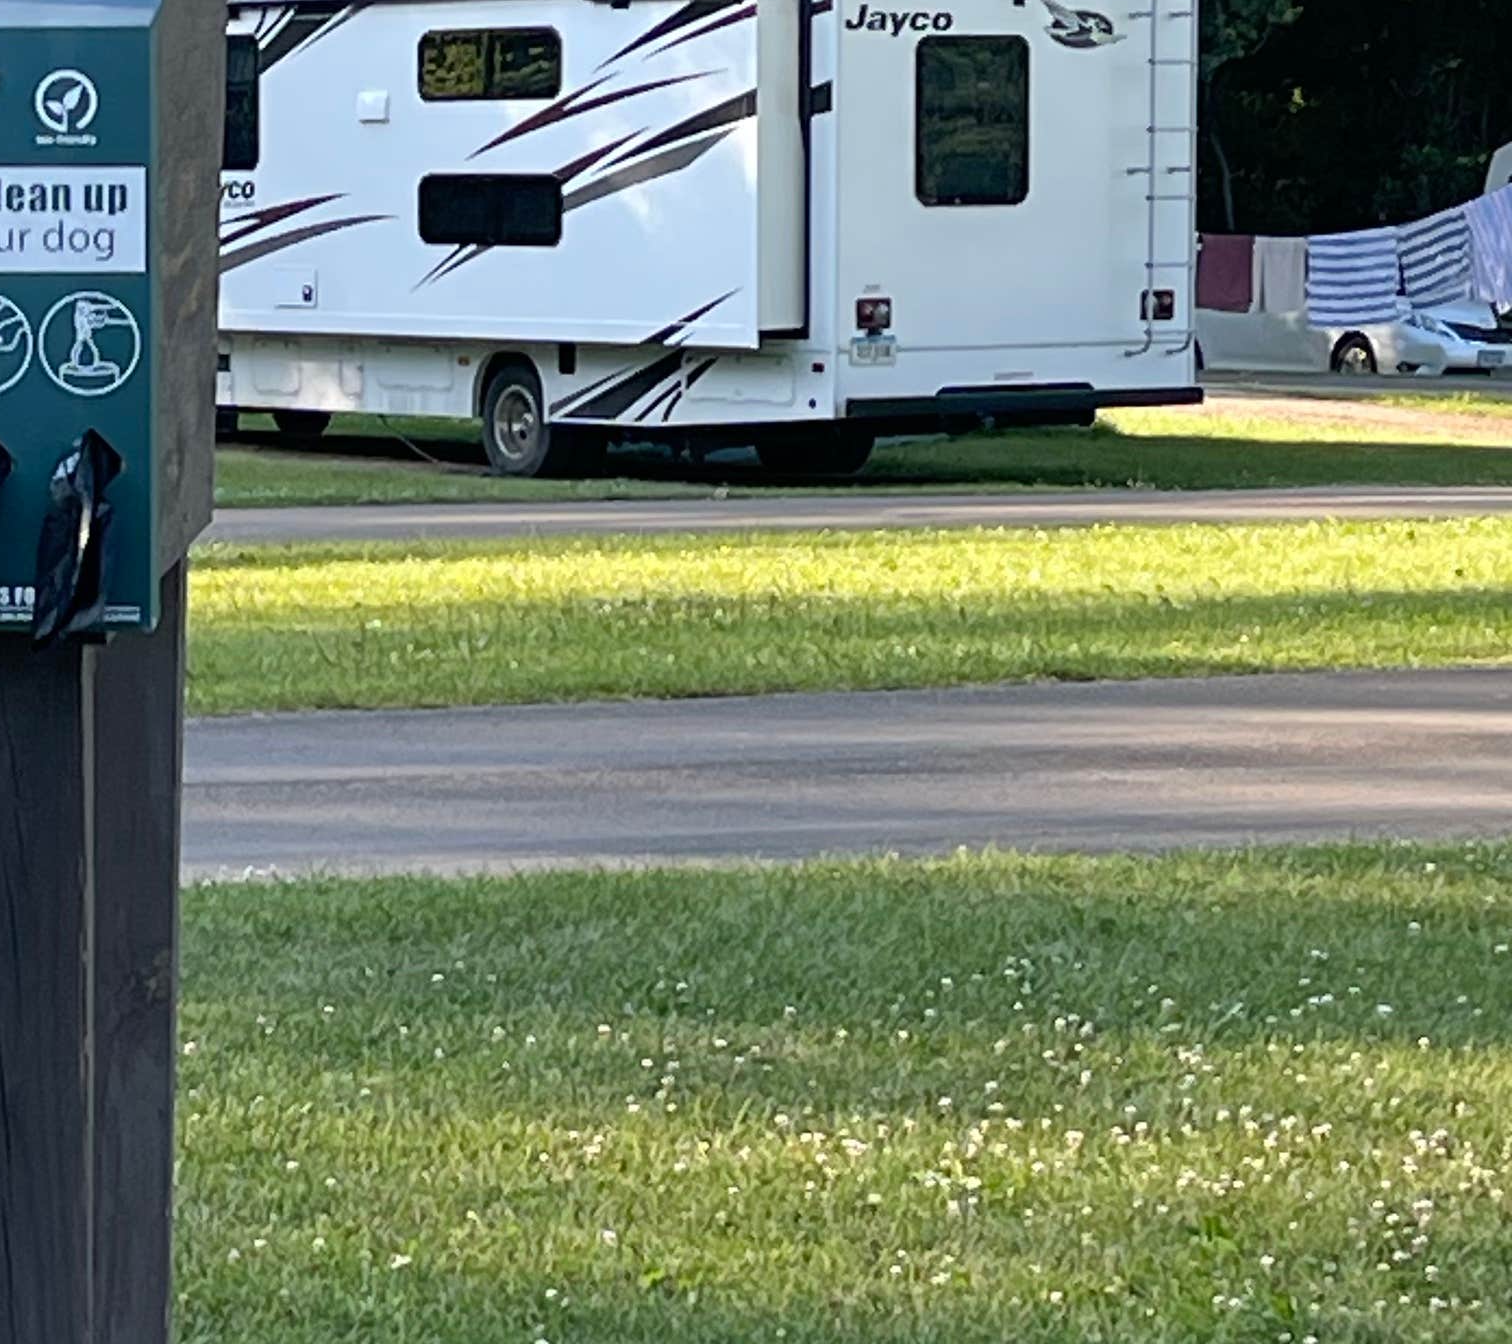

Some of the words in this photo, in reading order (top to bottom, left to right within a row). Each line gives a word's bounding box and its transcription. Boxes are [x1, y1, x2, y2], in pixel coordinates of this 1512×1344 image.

[845, 3, 953, 37] Jayco
[84, 183, 128, 215] up
[42, 219, 115, 261] dog
